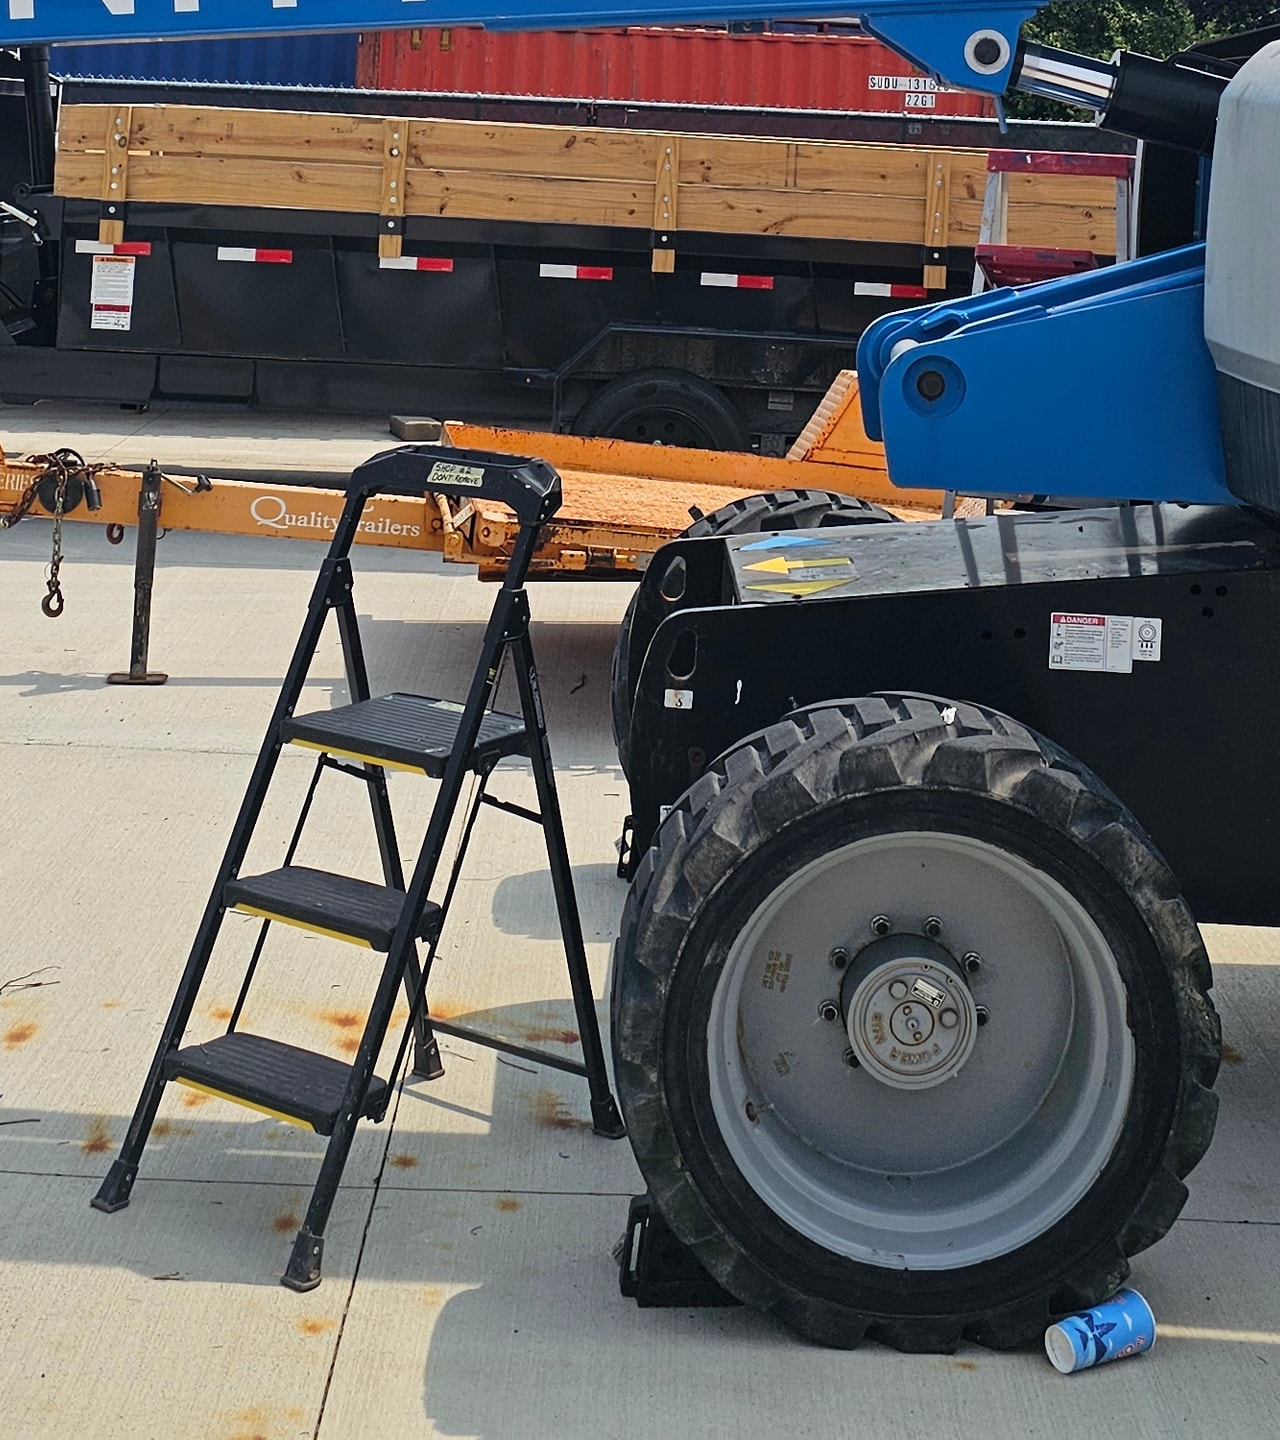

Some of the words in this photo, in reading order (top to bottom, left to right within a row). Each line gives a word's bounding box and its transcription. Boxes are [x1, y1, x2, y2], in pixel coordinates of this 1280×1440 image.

[870, 77, 898, 88] SUDU
[906, 95, 934, 106] 22G1
[436, 463, 456, 473] SHOP
[250, 496, 339, 533] Quality
[356, 504, 420, 537] railers
[1067, 617, 1098, 625] DANGER
